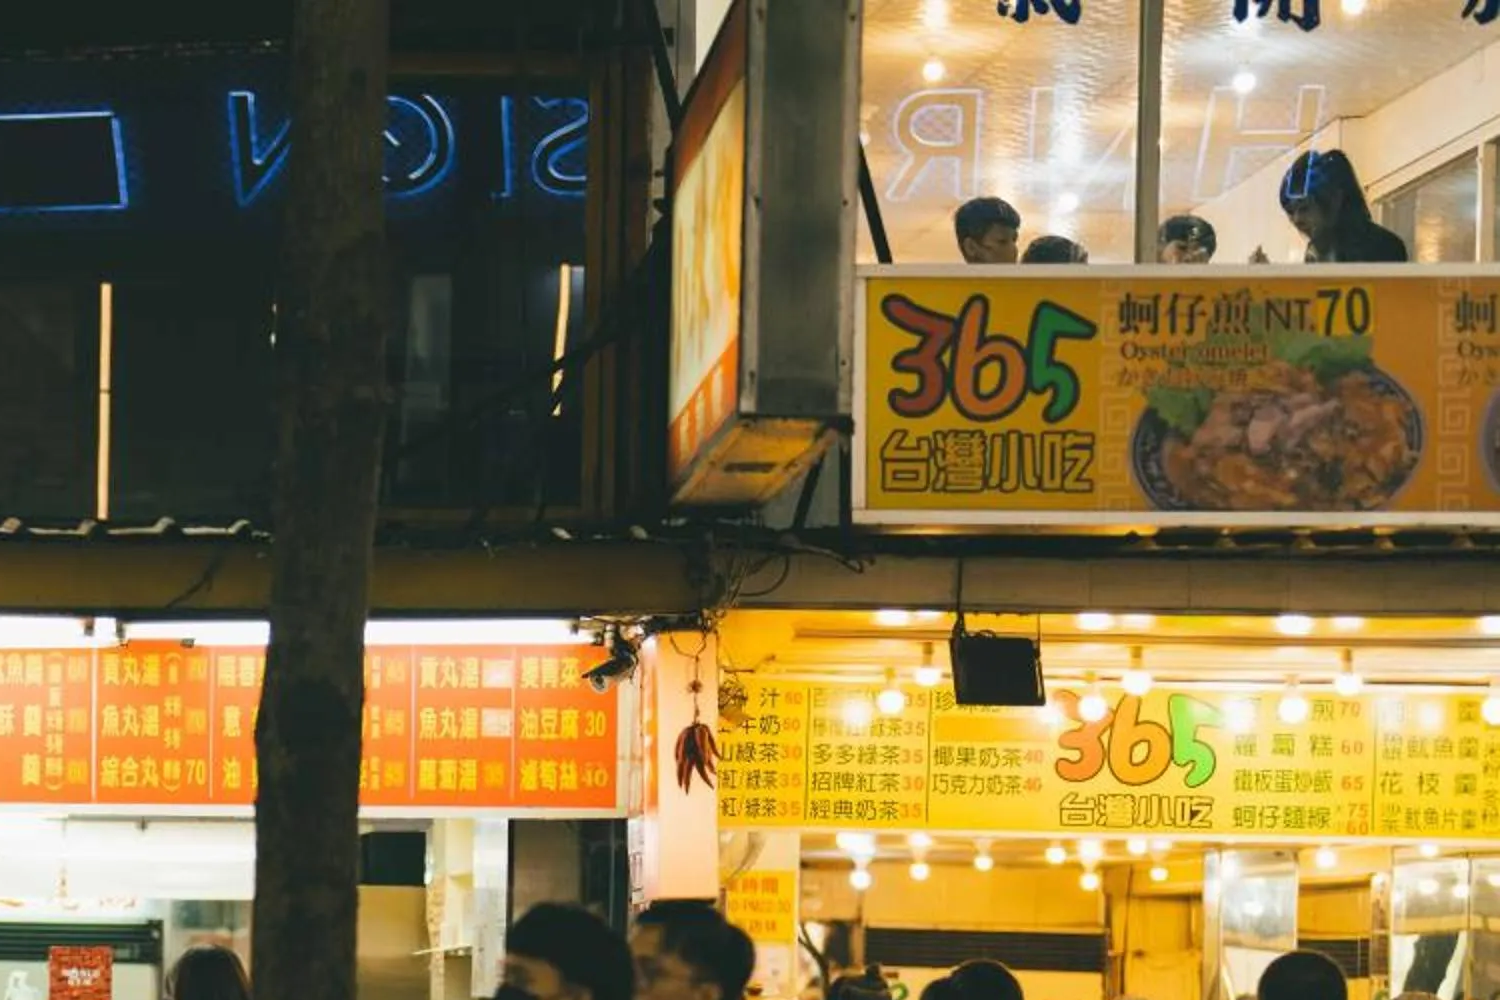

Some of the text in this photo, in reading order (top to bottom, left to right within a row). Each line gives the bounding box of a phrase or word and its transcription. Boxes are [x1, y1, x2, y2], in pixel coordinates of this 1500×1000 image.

[881, 294, 1097, 423] 365
[881, 429, 1094, 494] 台灣小吃
[1053, 688, 1222, 788] 365
[811, 771, 901, 793] 招牌紅茶
[931, 773, 1022, 795] 巧克力奶茶
[809, 799, 900, 821] 經典奶茶
[1059, 793, 1214, 829] 台灣小吃
